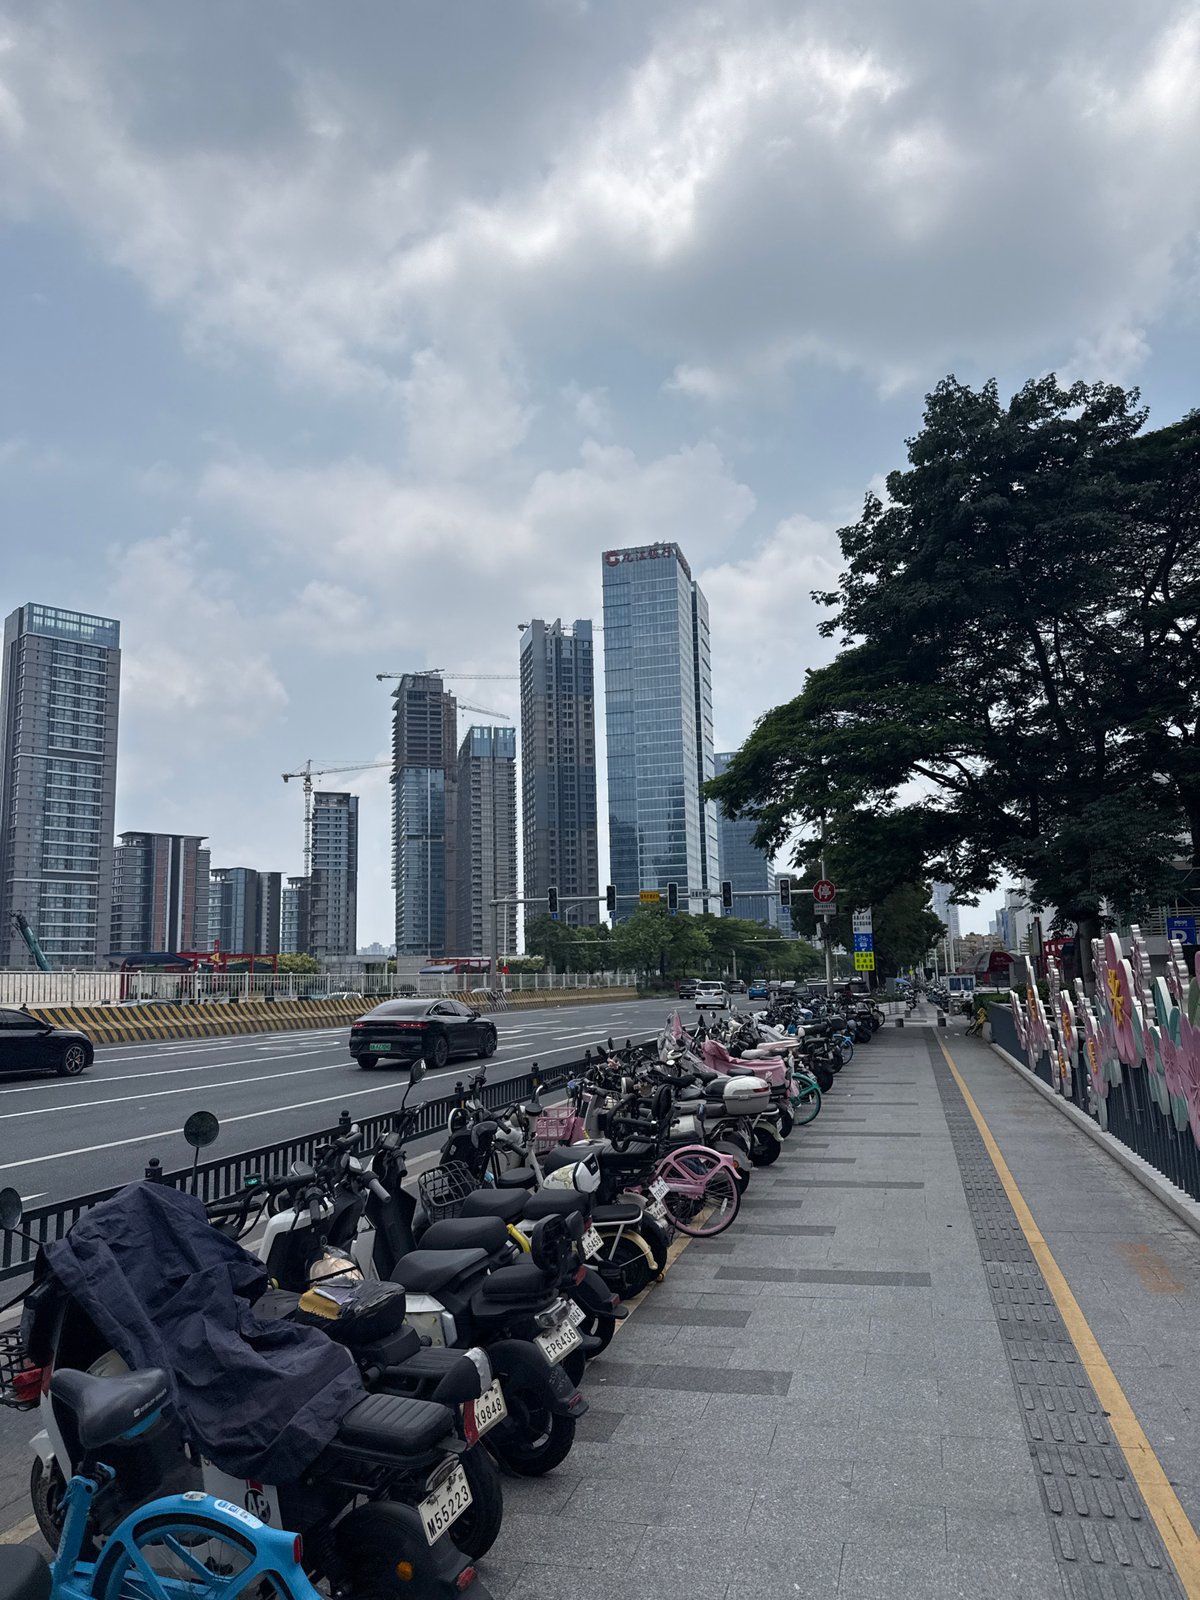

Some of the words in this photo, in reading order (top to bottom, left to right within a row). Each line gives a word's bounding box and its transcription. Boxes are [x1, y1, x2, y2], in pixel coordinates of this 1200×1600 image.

[545, 1329, 576, 1358] FP6436
[475, 1397, 502, 1428] X9848
[427, 1485, 469, 1539] M55223
